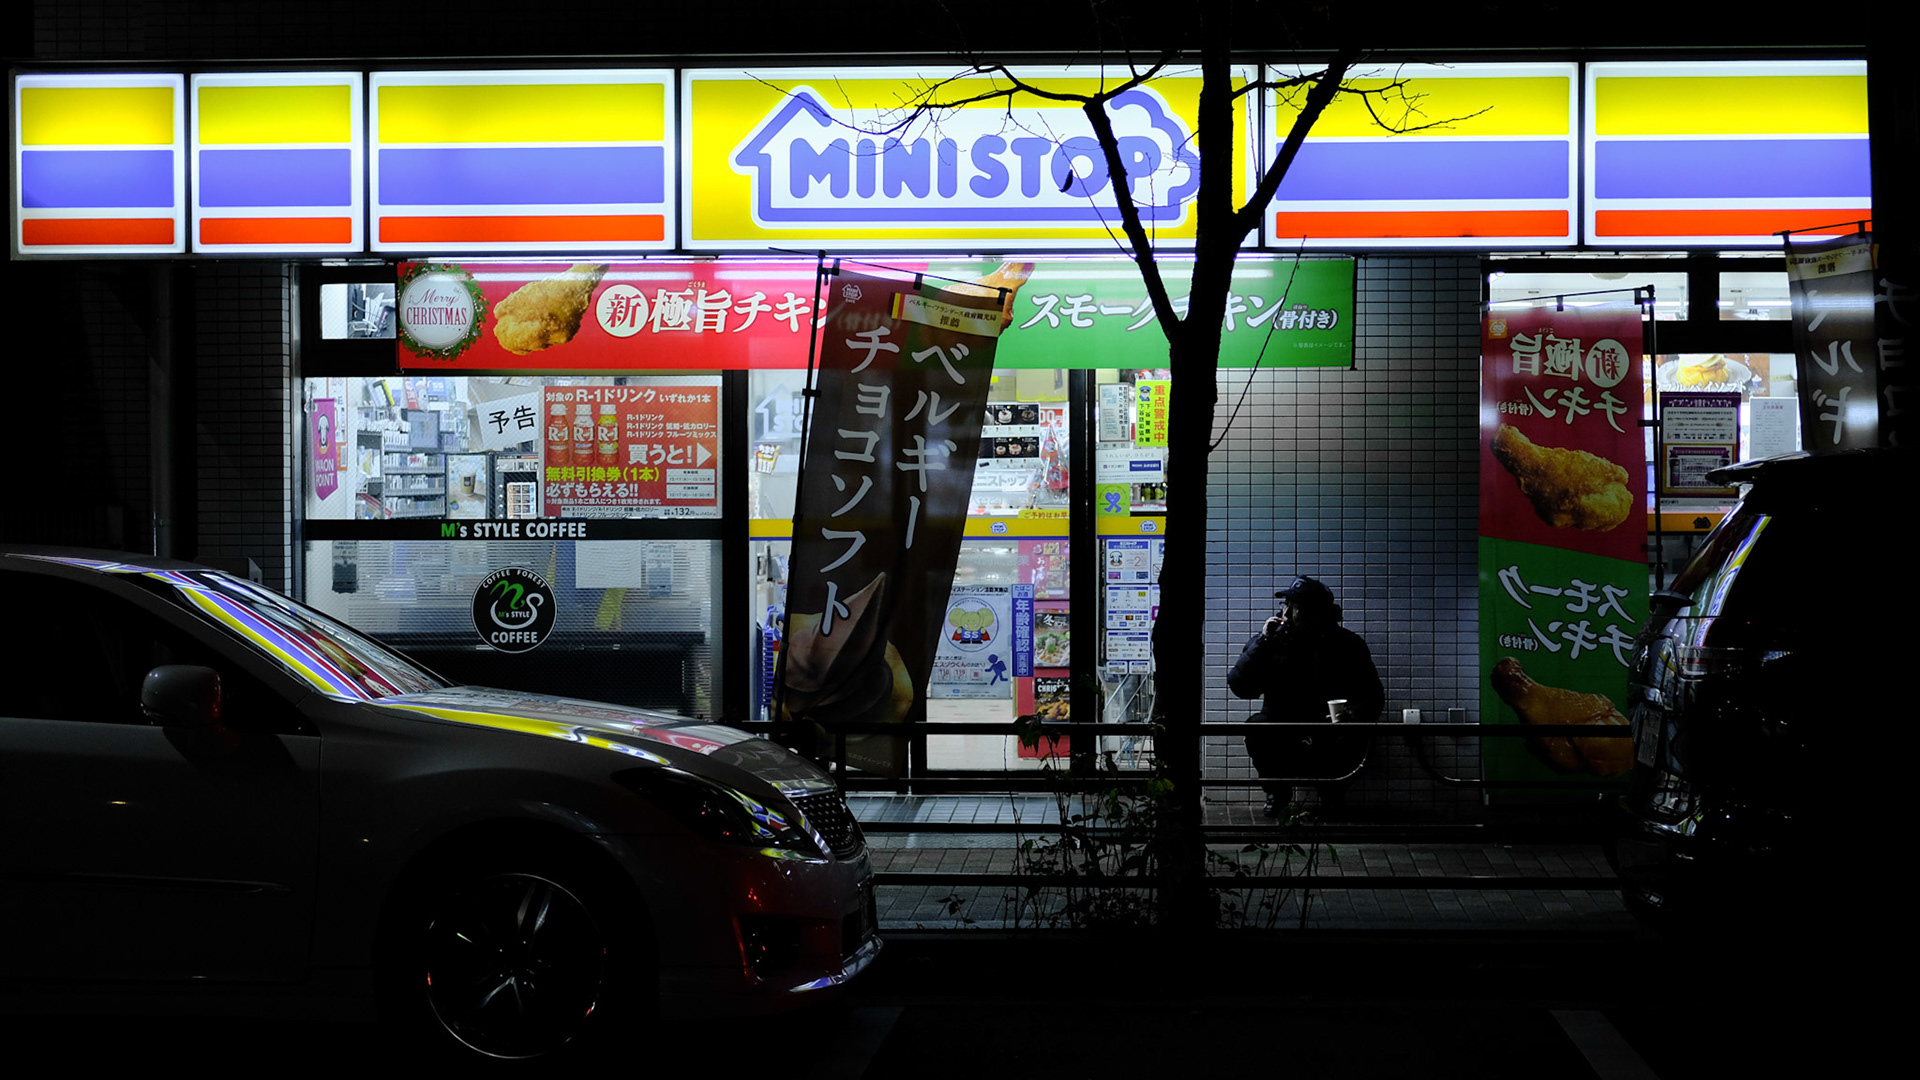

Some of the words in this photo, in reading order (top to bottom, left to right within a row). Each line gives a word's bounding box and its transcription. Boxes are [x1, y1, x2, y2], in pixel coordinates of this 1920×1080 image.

[415, 288, 456, 307] Merry
[406, 307, 468, 325] CHRISTMAS
[659, 393, 711, 403] いずれか1本
[488, 405, 537, 434] 予告
[626, 413, 665, 421] R-1ドリンク
[548, 426, 569, 441] R-1
[573, 426, 594, 441] R-1
[597, 426, 618, 441] R-1
[626, 422, 664, 430] R-1ドリンク
[896, 343, 970, 549] ベルギー
[315, 458, 334, 472] WAON
[315, 473, 335, 487] POINT
[820, 325, 900, 636] チョコソフト
[972, 475, 1028, 487] ニストップ
[441, 522, 468, 538] M's
[473, 522, 520, 538] STYLE
[525, 522, 587, 538] COFFEE
[482, 569, 511, 589] COFFEE
[516, 569, 547, 589] FOREST
[1015, 600, 1030, 653] 年齢確認
[490, 631, 538, 643] COFFEE
[963, 630, 979, 639] SS
